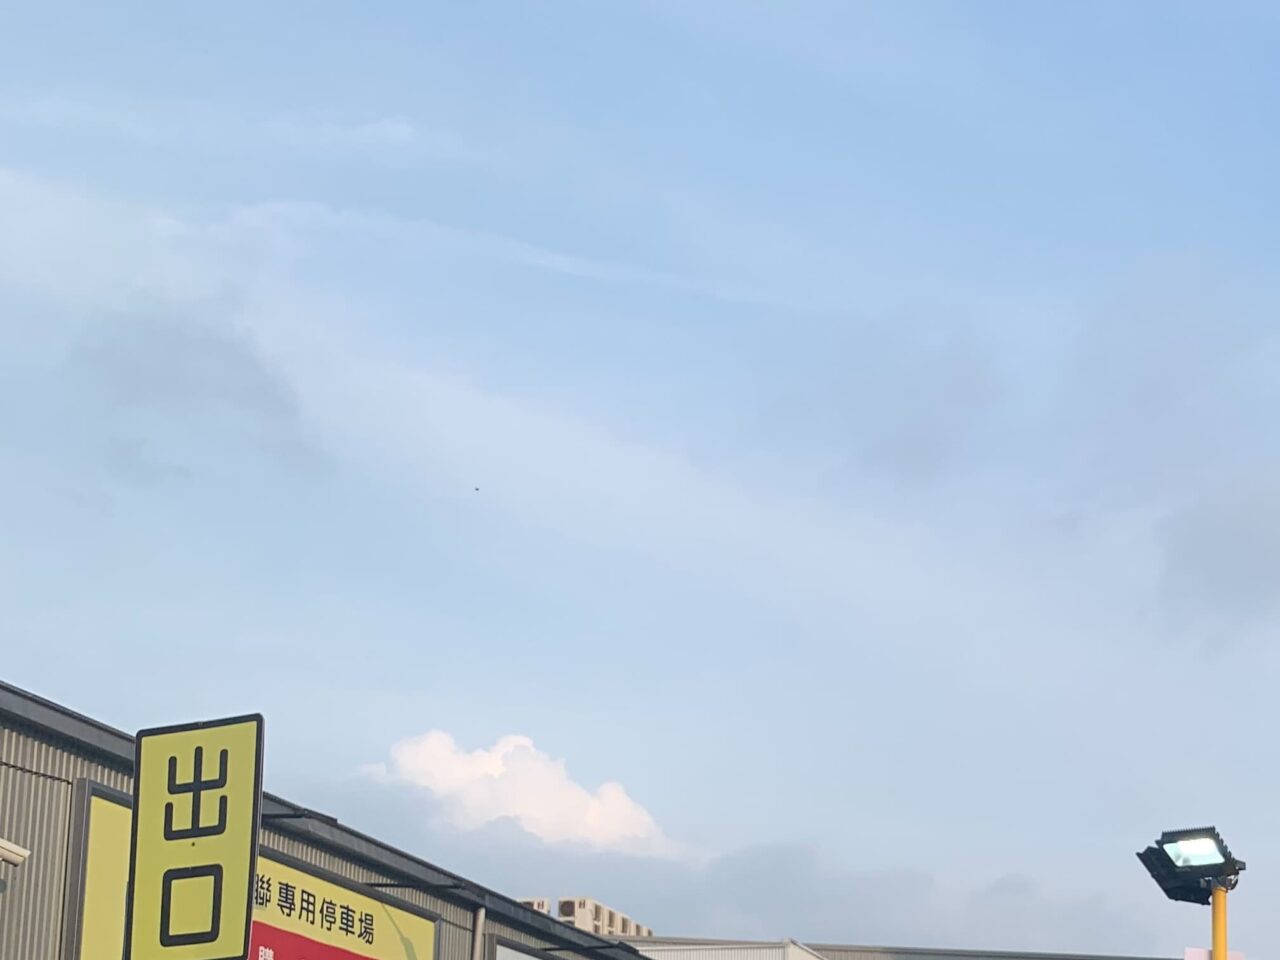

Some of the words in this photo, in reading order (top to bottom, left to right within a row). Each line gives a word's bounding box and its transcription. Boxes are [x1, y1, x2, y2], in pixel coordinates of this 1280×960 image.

[159, 745, 230, 948] 出口
[277, 881, 376, 946] 專用停車場
